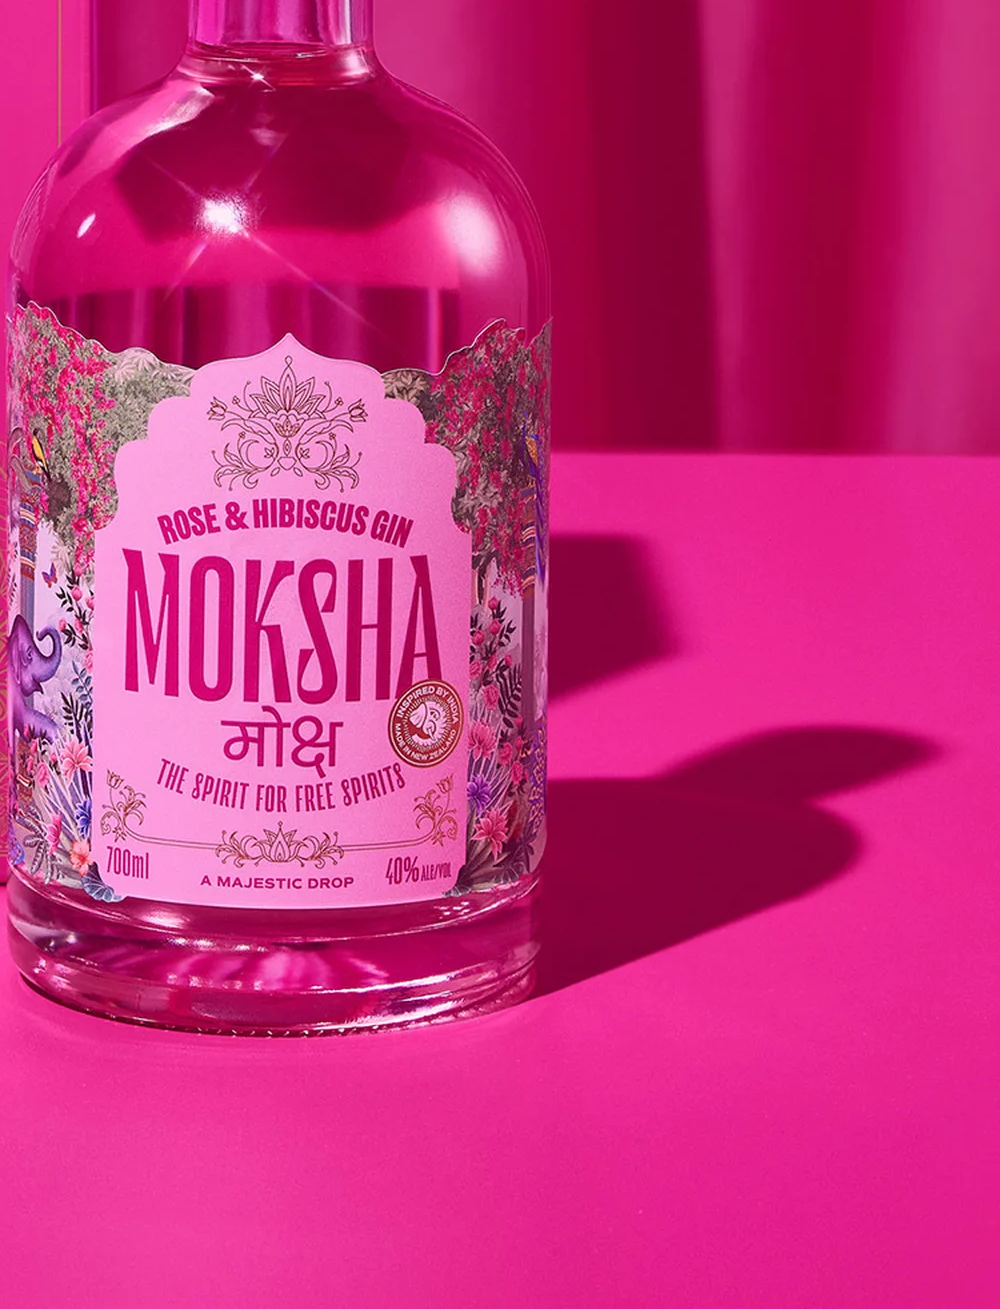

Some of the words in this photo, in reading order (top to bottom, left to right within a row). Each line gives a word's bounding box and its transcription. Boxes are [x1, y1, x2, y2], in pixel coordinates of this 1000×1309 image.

[157, 503, 220, 546] ROSE
[225, 500, 250, 532] &
[252, 497, 369, 537] HIBISCUS
[369, 509, 415, 549] GIN
[122, 547, 443, 705] MOKSHA
[396, 686, 435, 718] INSPIRED
[436, 686, 449, 698] BY
[446, 696, 459, 725] INDIA
[221, 705, 344, 779] मोक्ष
[156, 758, 186, 794] THE
[191, 772, 250, 811] SPIRIT
[255, 783, 288, 813] FOR
[298, 782, 337, 813] FREE
[341, 762, 406, 805] SPIRITS
[106, 845, 150, 881] 700ml
[200, 875, 213, 887] A
[217, 874, 302, 890] MAJESTIC
[308, 876, 355, 890] DROP
[385, 856, 419, 885] 40%
